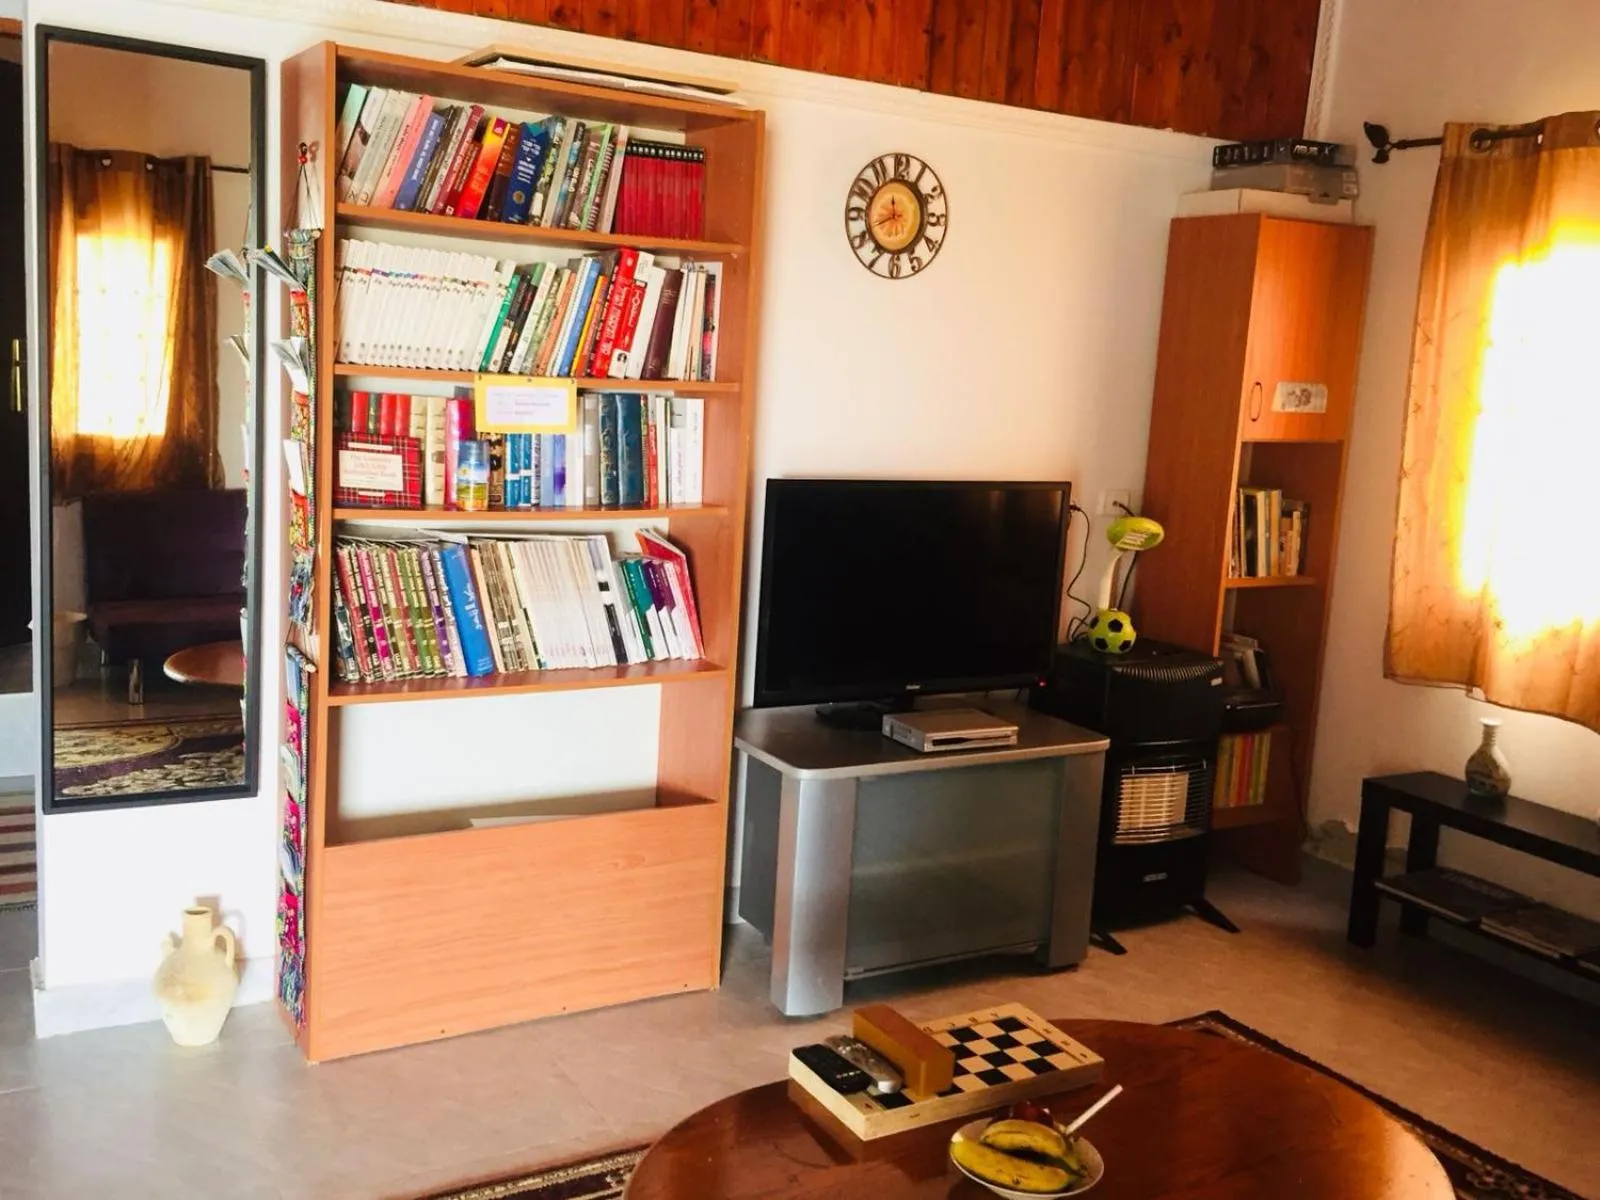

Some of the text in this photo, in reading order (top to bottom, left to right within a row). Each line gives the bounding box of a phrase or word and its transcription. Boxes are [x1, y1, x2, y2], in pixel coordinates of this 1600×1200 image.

[894, 154, 910, 180] 12
[847, 206, 865, 221] 9
[928, 212, 946, 226] 3
[923, 235, 939, 252] 4
[888, 255, 901, 278] 6
[908, 248, 923, 272] 5
